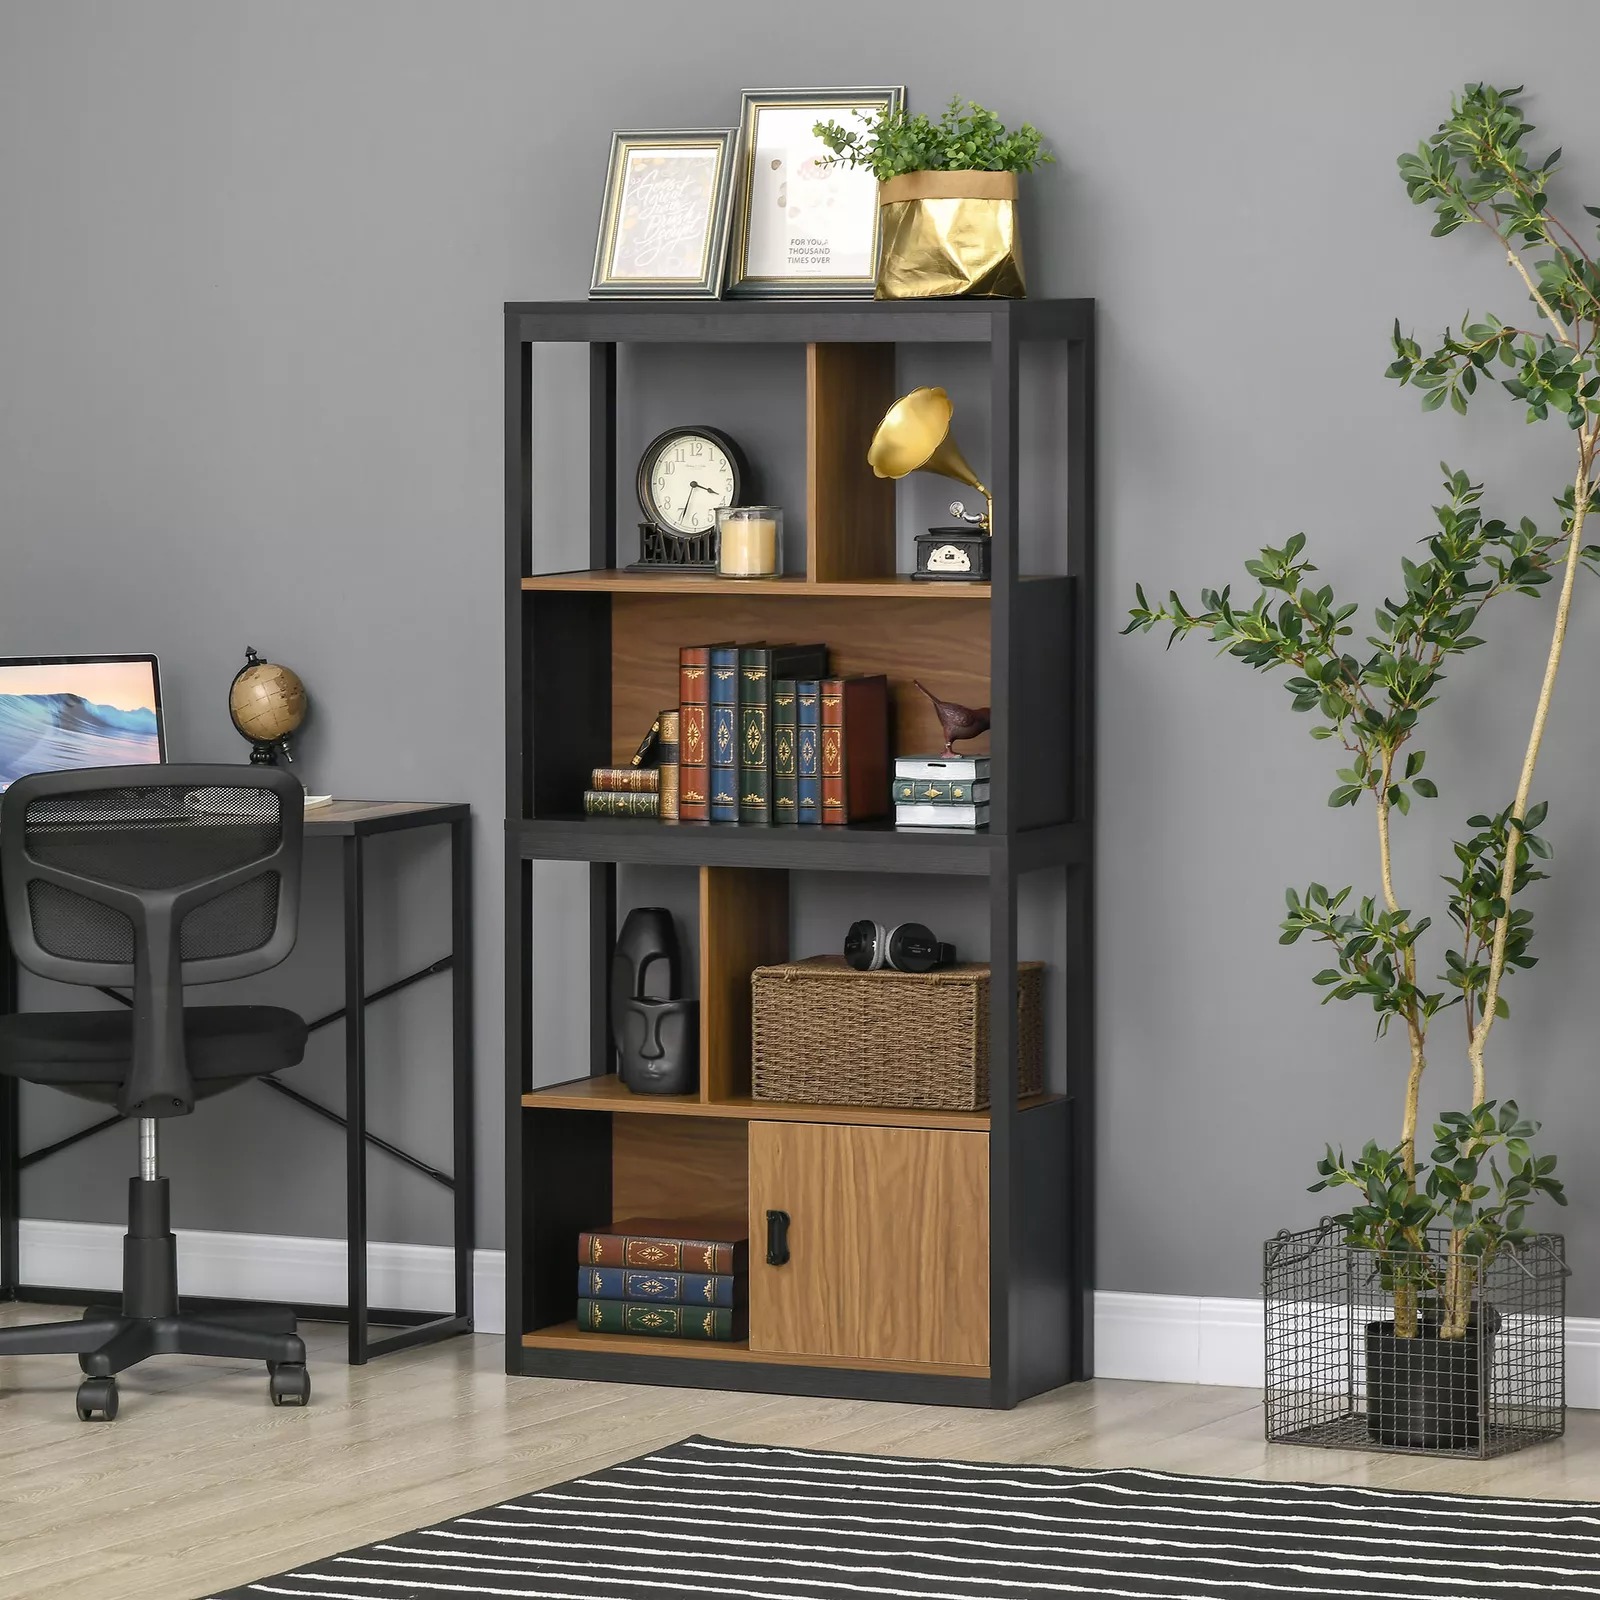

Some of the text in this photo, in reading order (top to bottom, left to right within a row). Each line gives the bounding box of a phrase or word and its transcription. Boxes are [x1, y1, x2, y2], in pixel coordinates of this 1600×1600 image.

[790, 238, 806, 246] FOR
[788, 247, 831, 255] THOUSAND
[787, 256, 831, 264] TIMES OVER
[675, 448, 686, 463] 11
[690, 442, 703, 457] 12
[708, 447, 715, 462] 1
[664, 460, 676, 475] 10
[719, 458, 727, 473] 2
[658, 476, 666, 491] 9
[726, 477, 733, 493] 3
[664, 495, 672, 511] 8
[719, 495, 727, 506] 4
[677, 507, 685, 522] 7
[691, 512, 699, 527] 6
[707, 508, 714, 523] 5
[637, 522, 717, 564] FAMIL
